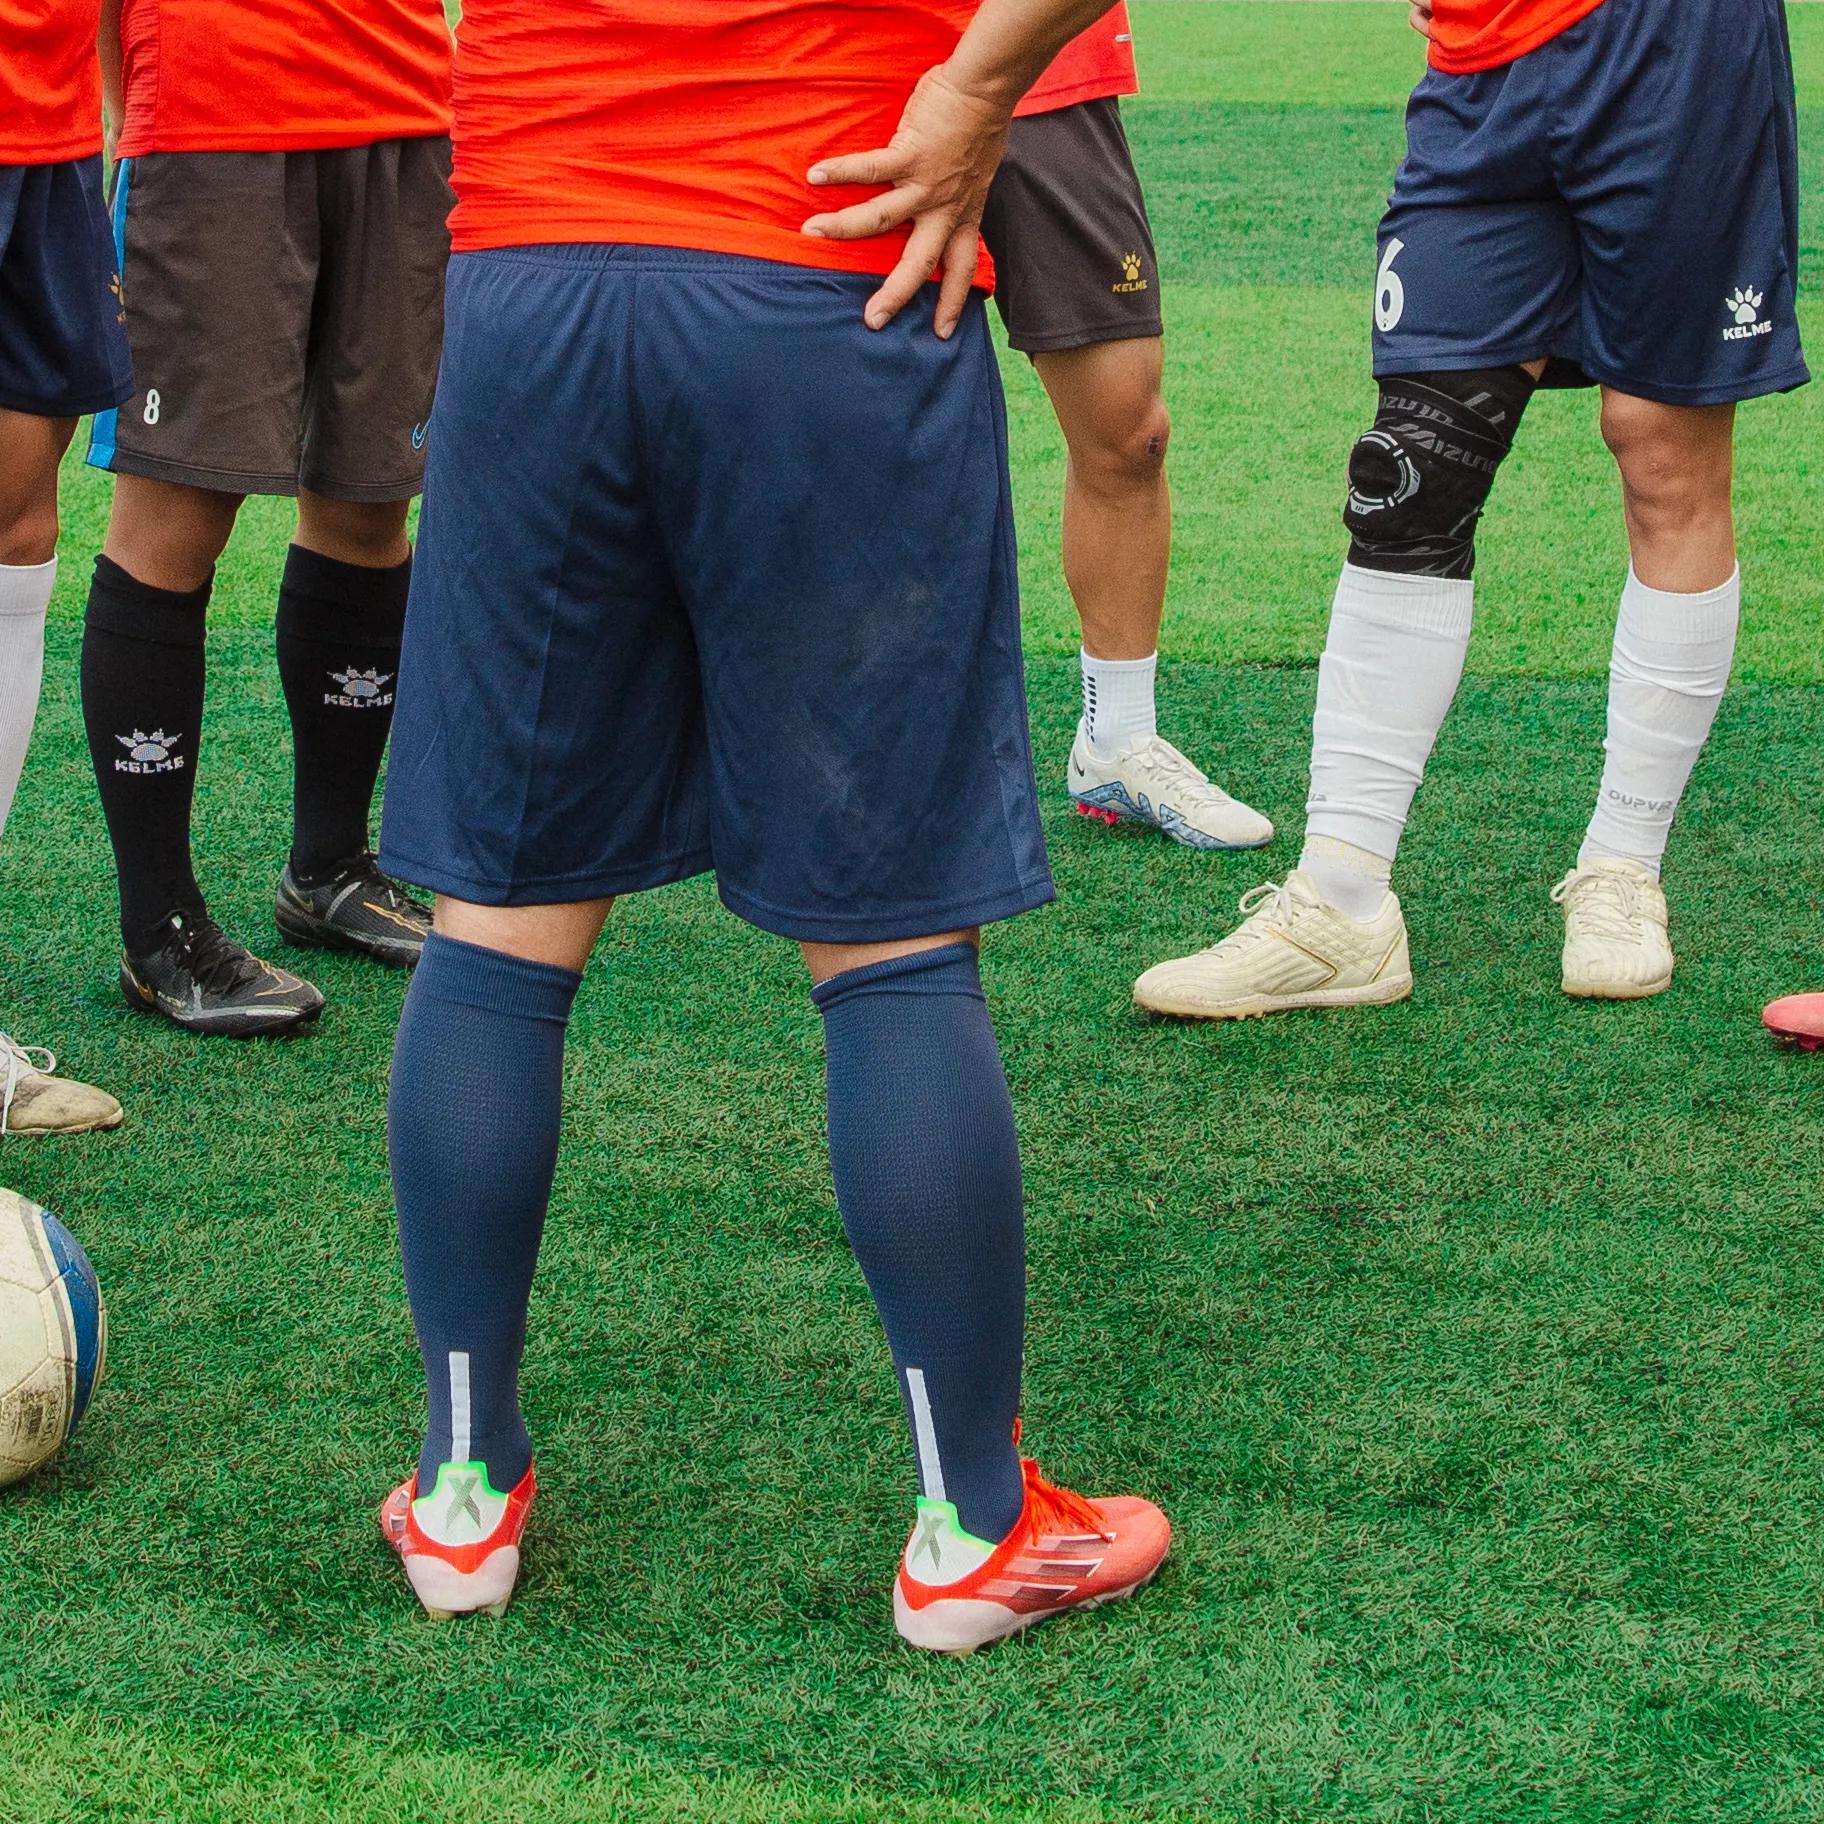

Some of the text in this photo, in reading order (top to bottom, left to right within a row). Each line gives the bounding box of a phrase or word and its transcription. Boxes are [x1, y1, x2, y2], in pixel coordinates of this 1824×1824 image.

[1111, 279, 1149, 293] KELME
[1722, 320, 1773, 341] KELME
[142, 387, 161, 425] 8
[323, 692, 393, 709] KELME
[114, 755, 185, 774] KELME
